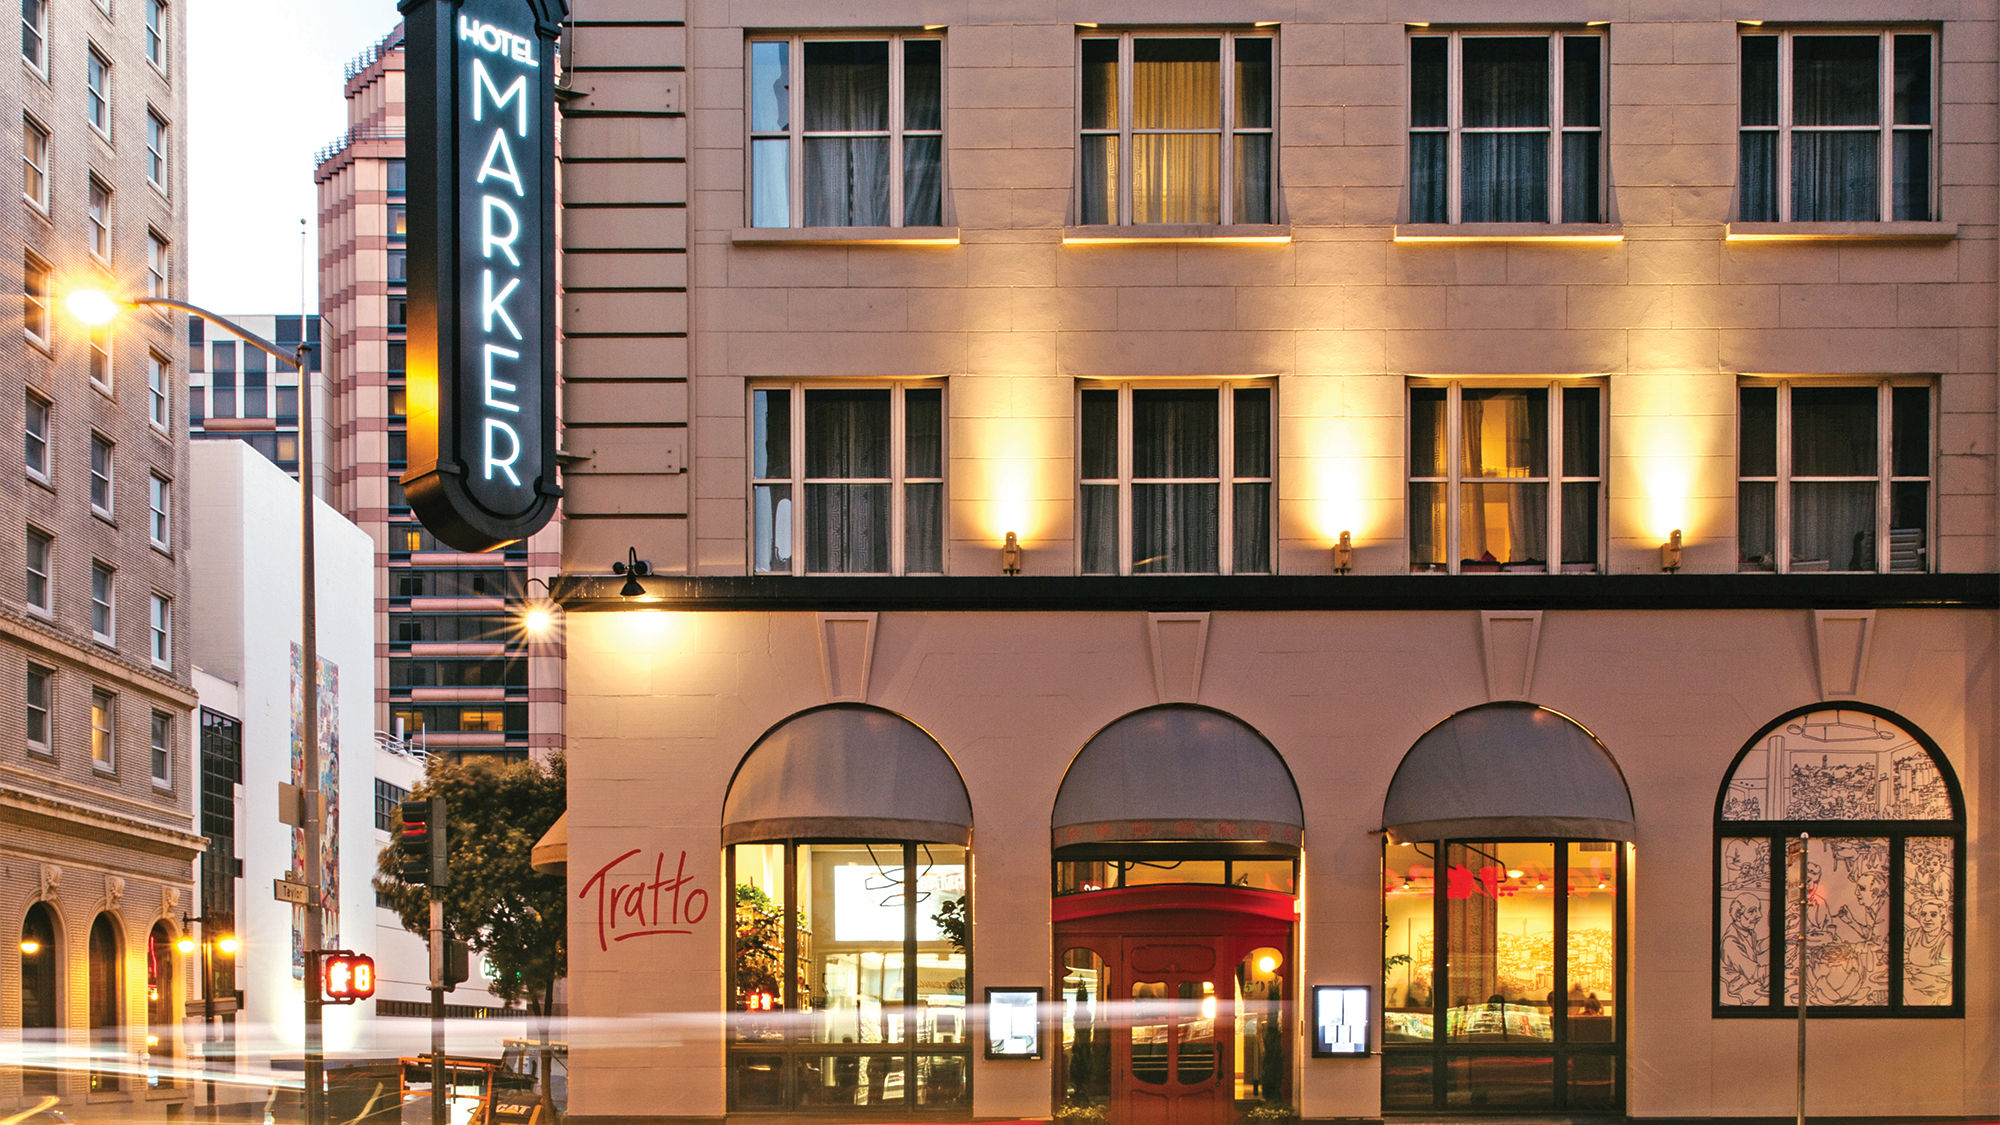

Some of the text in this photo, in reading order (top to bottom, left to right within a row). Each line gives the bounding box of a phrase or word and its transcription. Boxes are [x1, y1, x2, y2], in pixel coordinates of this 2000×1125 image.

[460, 14, 539, 67] HOTEL
[473, 58, 526, 487] MARKER
[579, 848, 709, 952] Tratto
[495, 1103, 531, 1115] CAT
